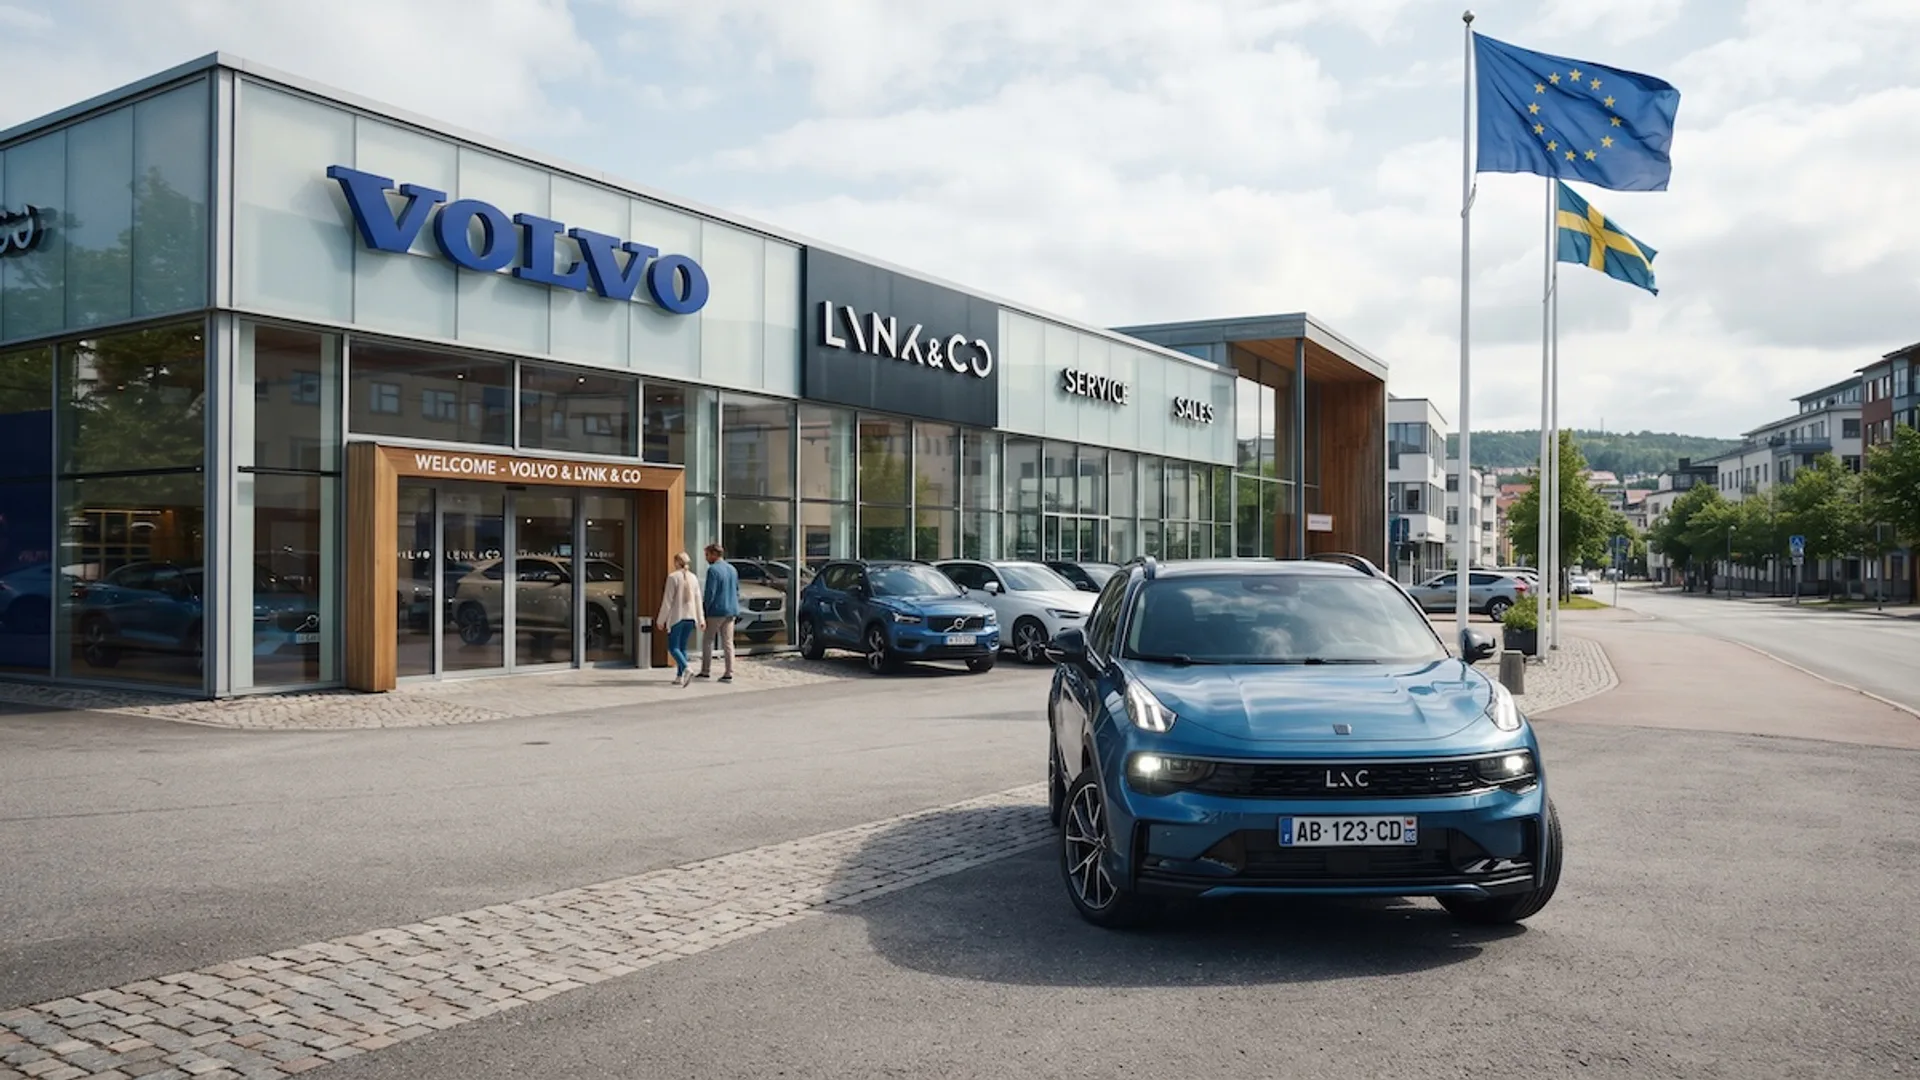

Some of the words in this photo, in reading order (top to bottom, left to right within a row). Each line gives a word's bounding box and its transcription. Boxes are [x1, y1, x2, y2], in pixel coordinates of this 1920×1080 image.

[326, 165, 710, 315] VOLVO
[1063, 367, 1131, 405] SERVICE
[1174, 396, 1215, 424] SALES
[415, 453, 496, 475] WELCOME
[509, 461, 558, 480] VOLVO
[560, 466, 571, 480] &
[574, 466, 608, 482] LYNK
[610, 468, 621, 482] &
[622, 469, 642, 484] CO
